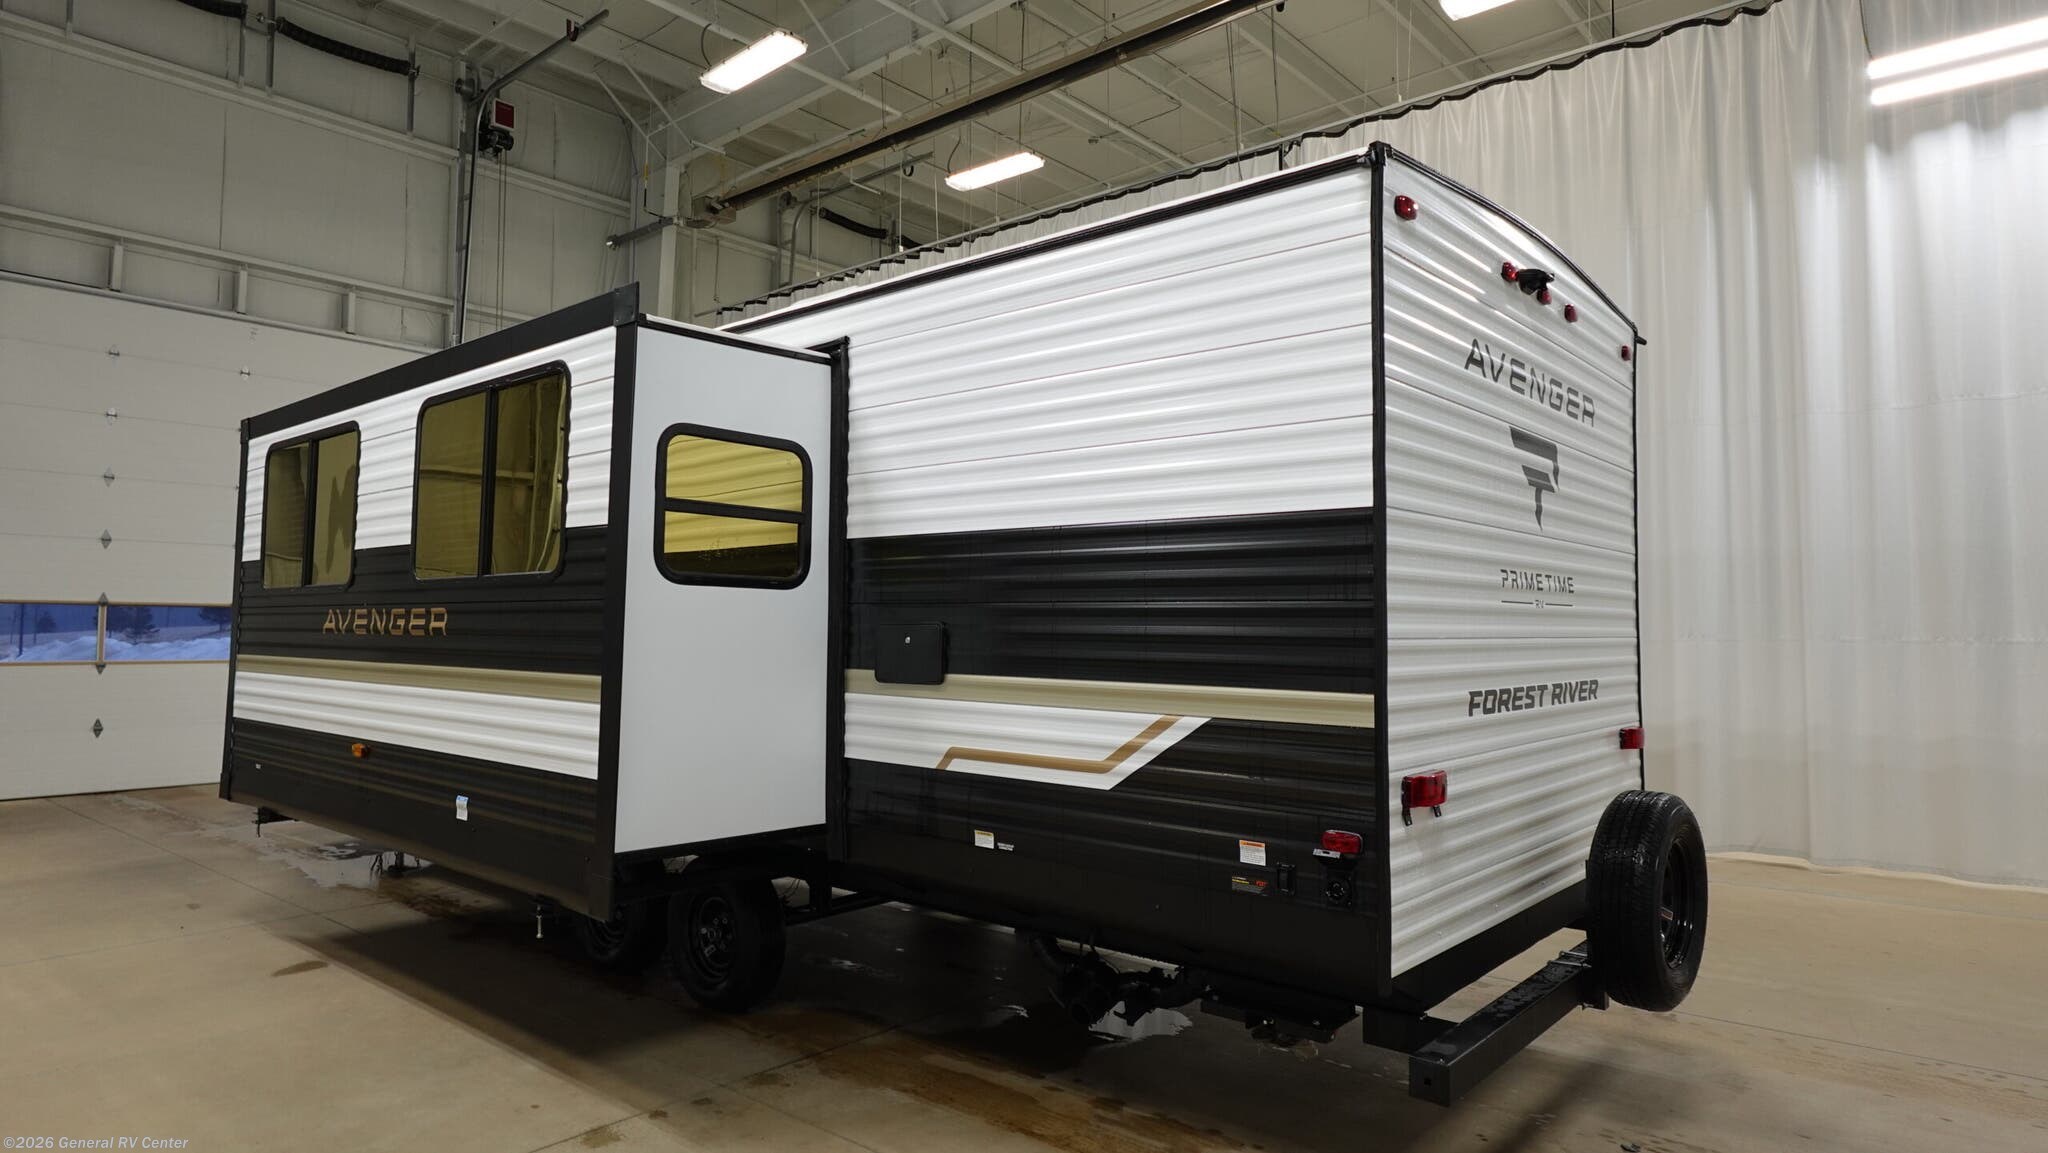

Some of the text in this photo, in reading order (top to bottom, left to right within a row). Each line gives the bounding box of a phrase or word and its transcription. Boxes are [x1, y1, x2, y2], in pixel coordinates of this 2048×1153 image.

[1464, 338, 1596, 427] AVENGER
[1535, 599, 1544, 609] RV
[323, 607, 448, 636] AVENGER
[1468, 679, 1599, 717] FOREST RIVER
